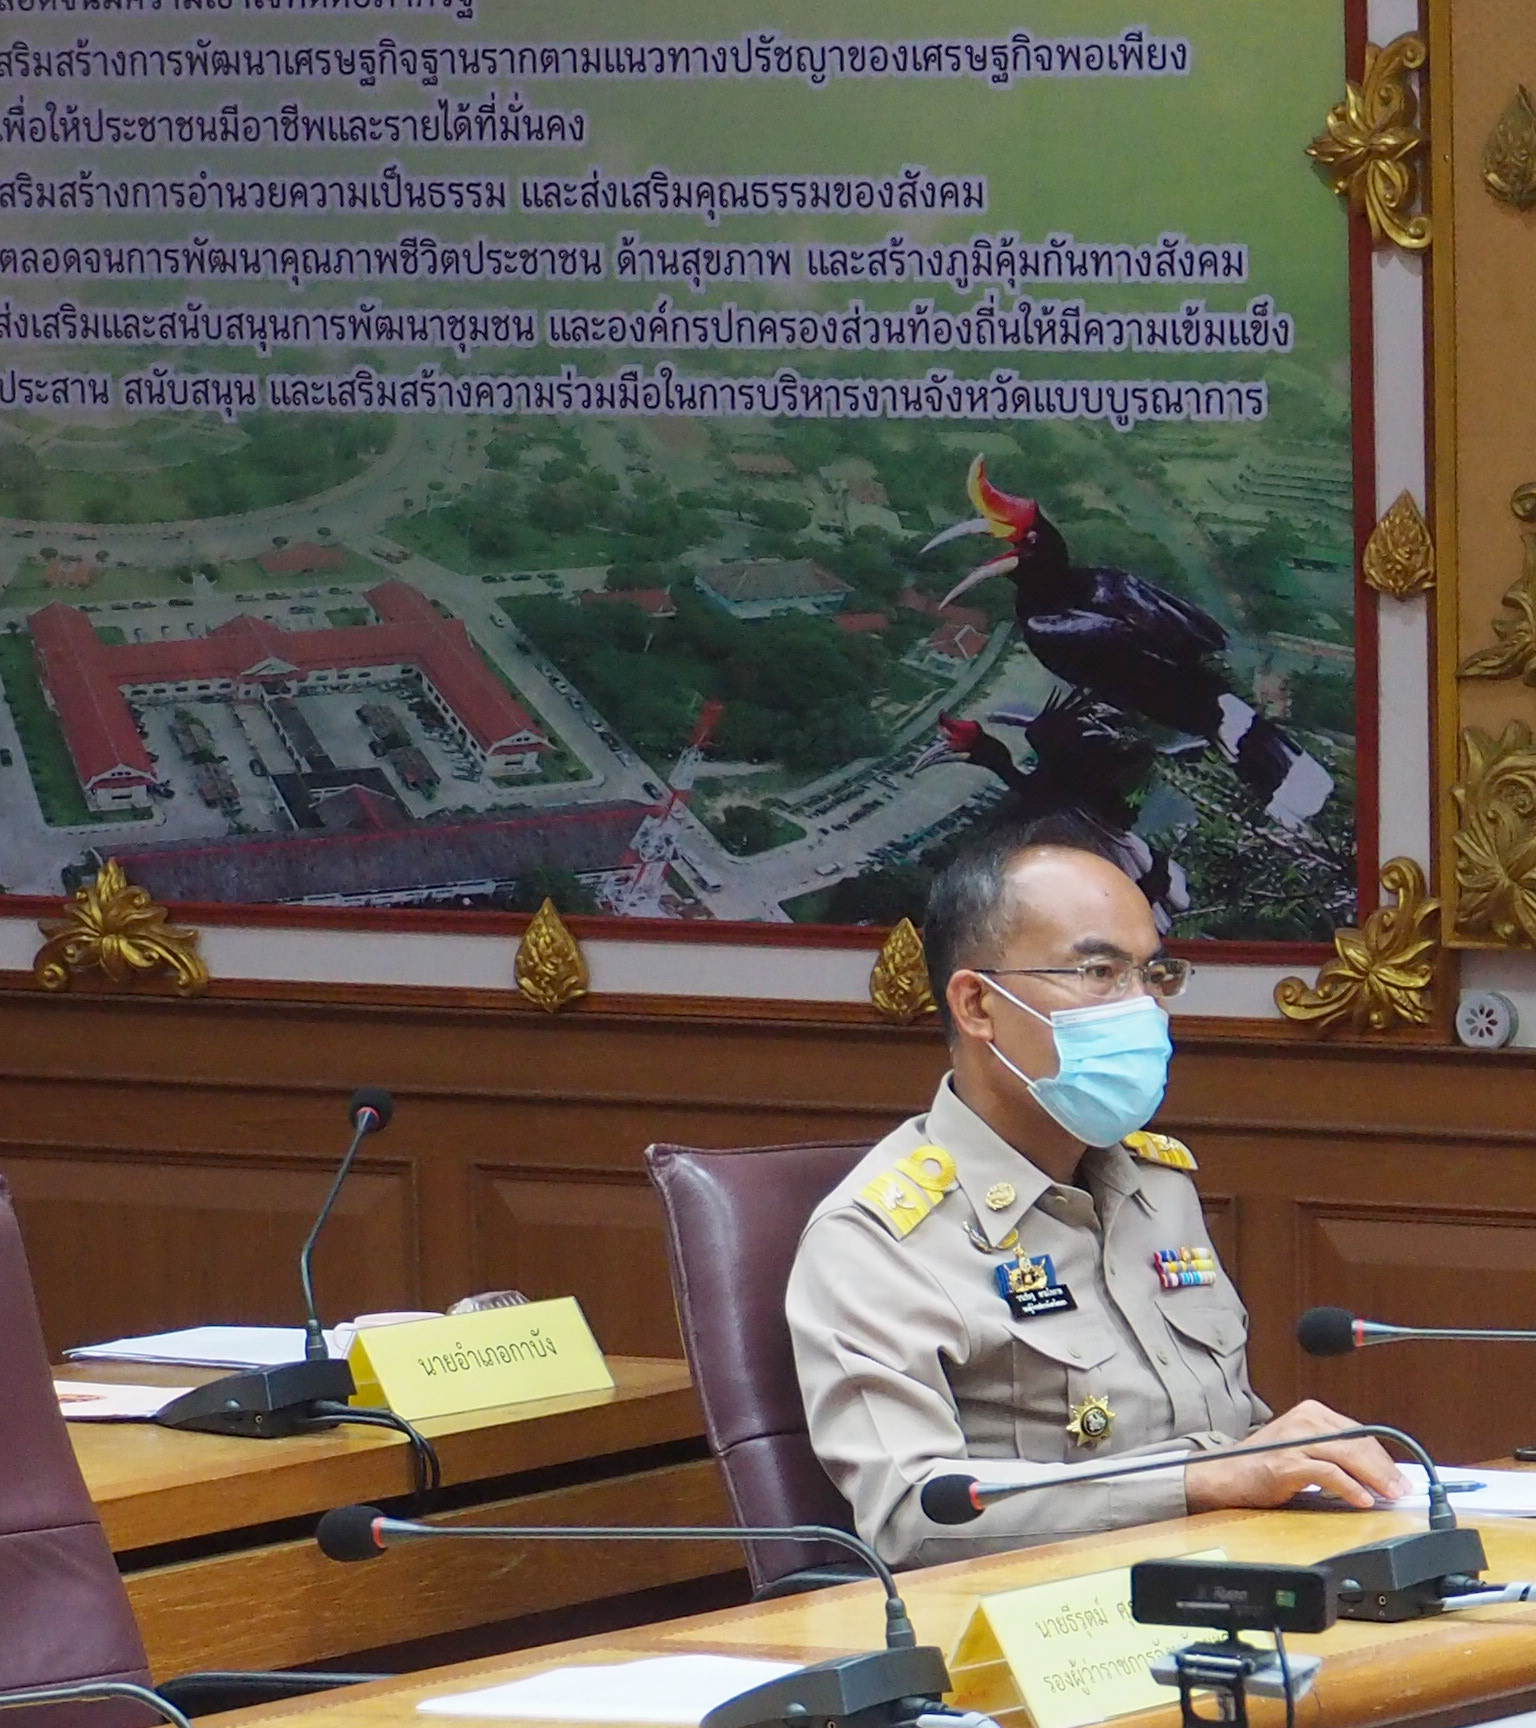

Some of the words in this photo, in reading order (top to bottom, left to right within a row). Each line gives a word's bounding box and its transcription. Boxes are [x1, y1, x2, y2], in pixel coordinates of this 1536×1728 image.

[522, 170, 984, 220] และส่งเสริมคุณธรรมของสังคม
[617, 237, 790, 287] ด้านสุขภาพ
[808, 237, 1243, 288] และสร้างภูมิคุ้มกันทางสังคม
[0, 370, 109, 405] ประสาน
[124, 368, 257, 419] สนับสนุน
[417, 1328, 558, 1377] นายอำเภอกาบัง
